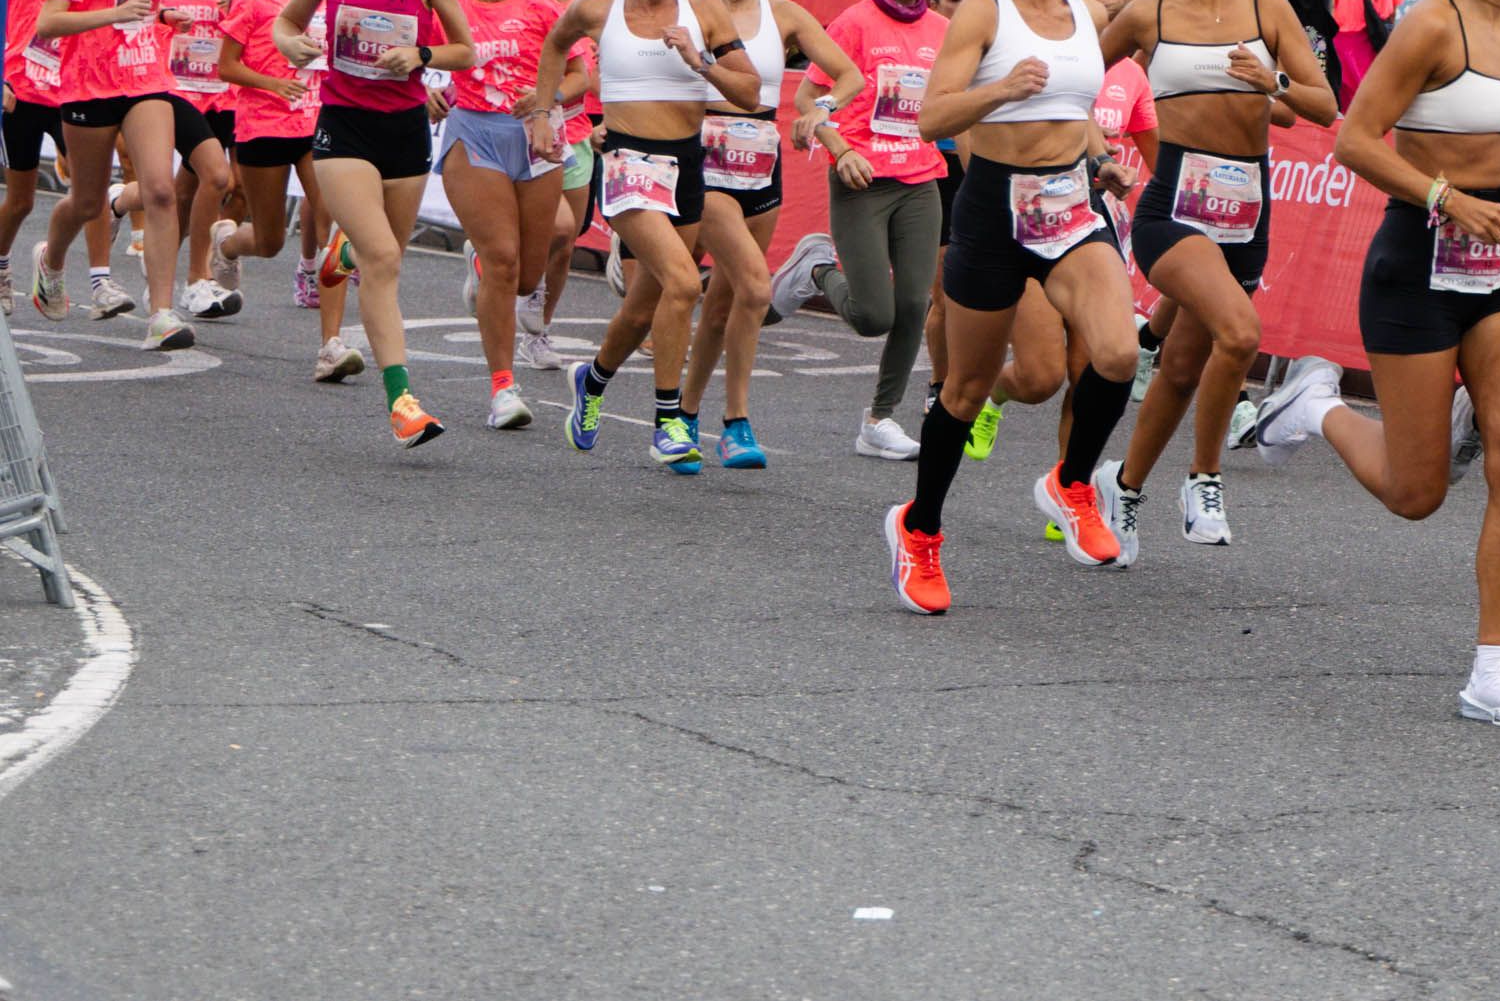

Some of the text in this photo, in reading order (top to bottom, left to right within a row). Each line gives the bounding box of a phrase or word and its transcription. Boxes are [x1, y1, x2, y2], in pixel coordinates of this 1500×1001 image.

[188, 62, 213, 73] 016
[726, 150, 757, 164] 016
[626, 174, 654, 191] 016
[1206, 197, 1241, 214] 016
